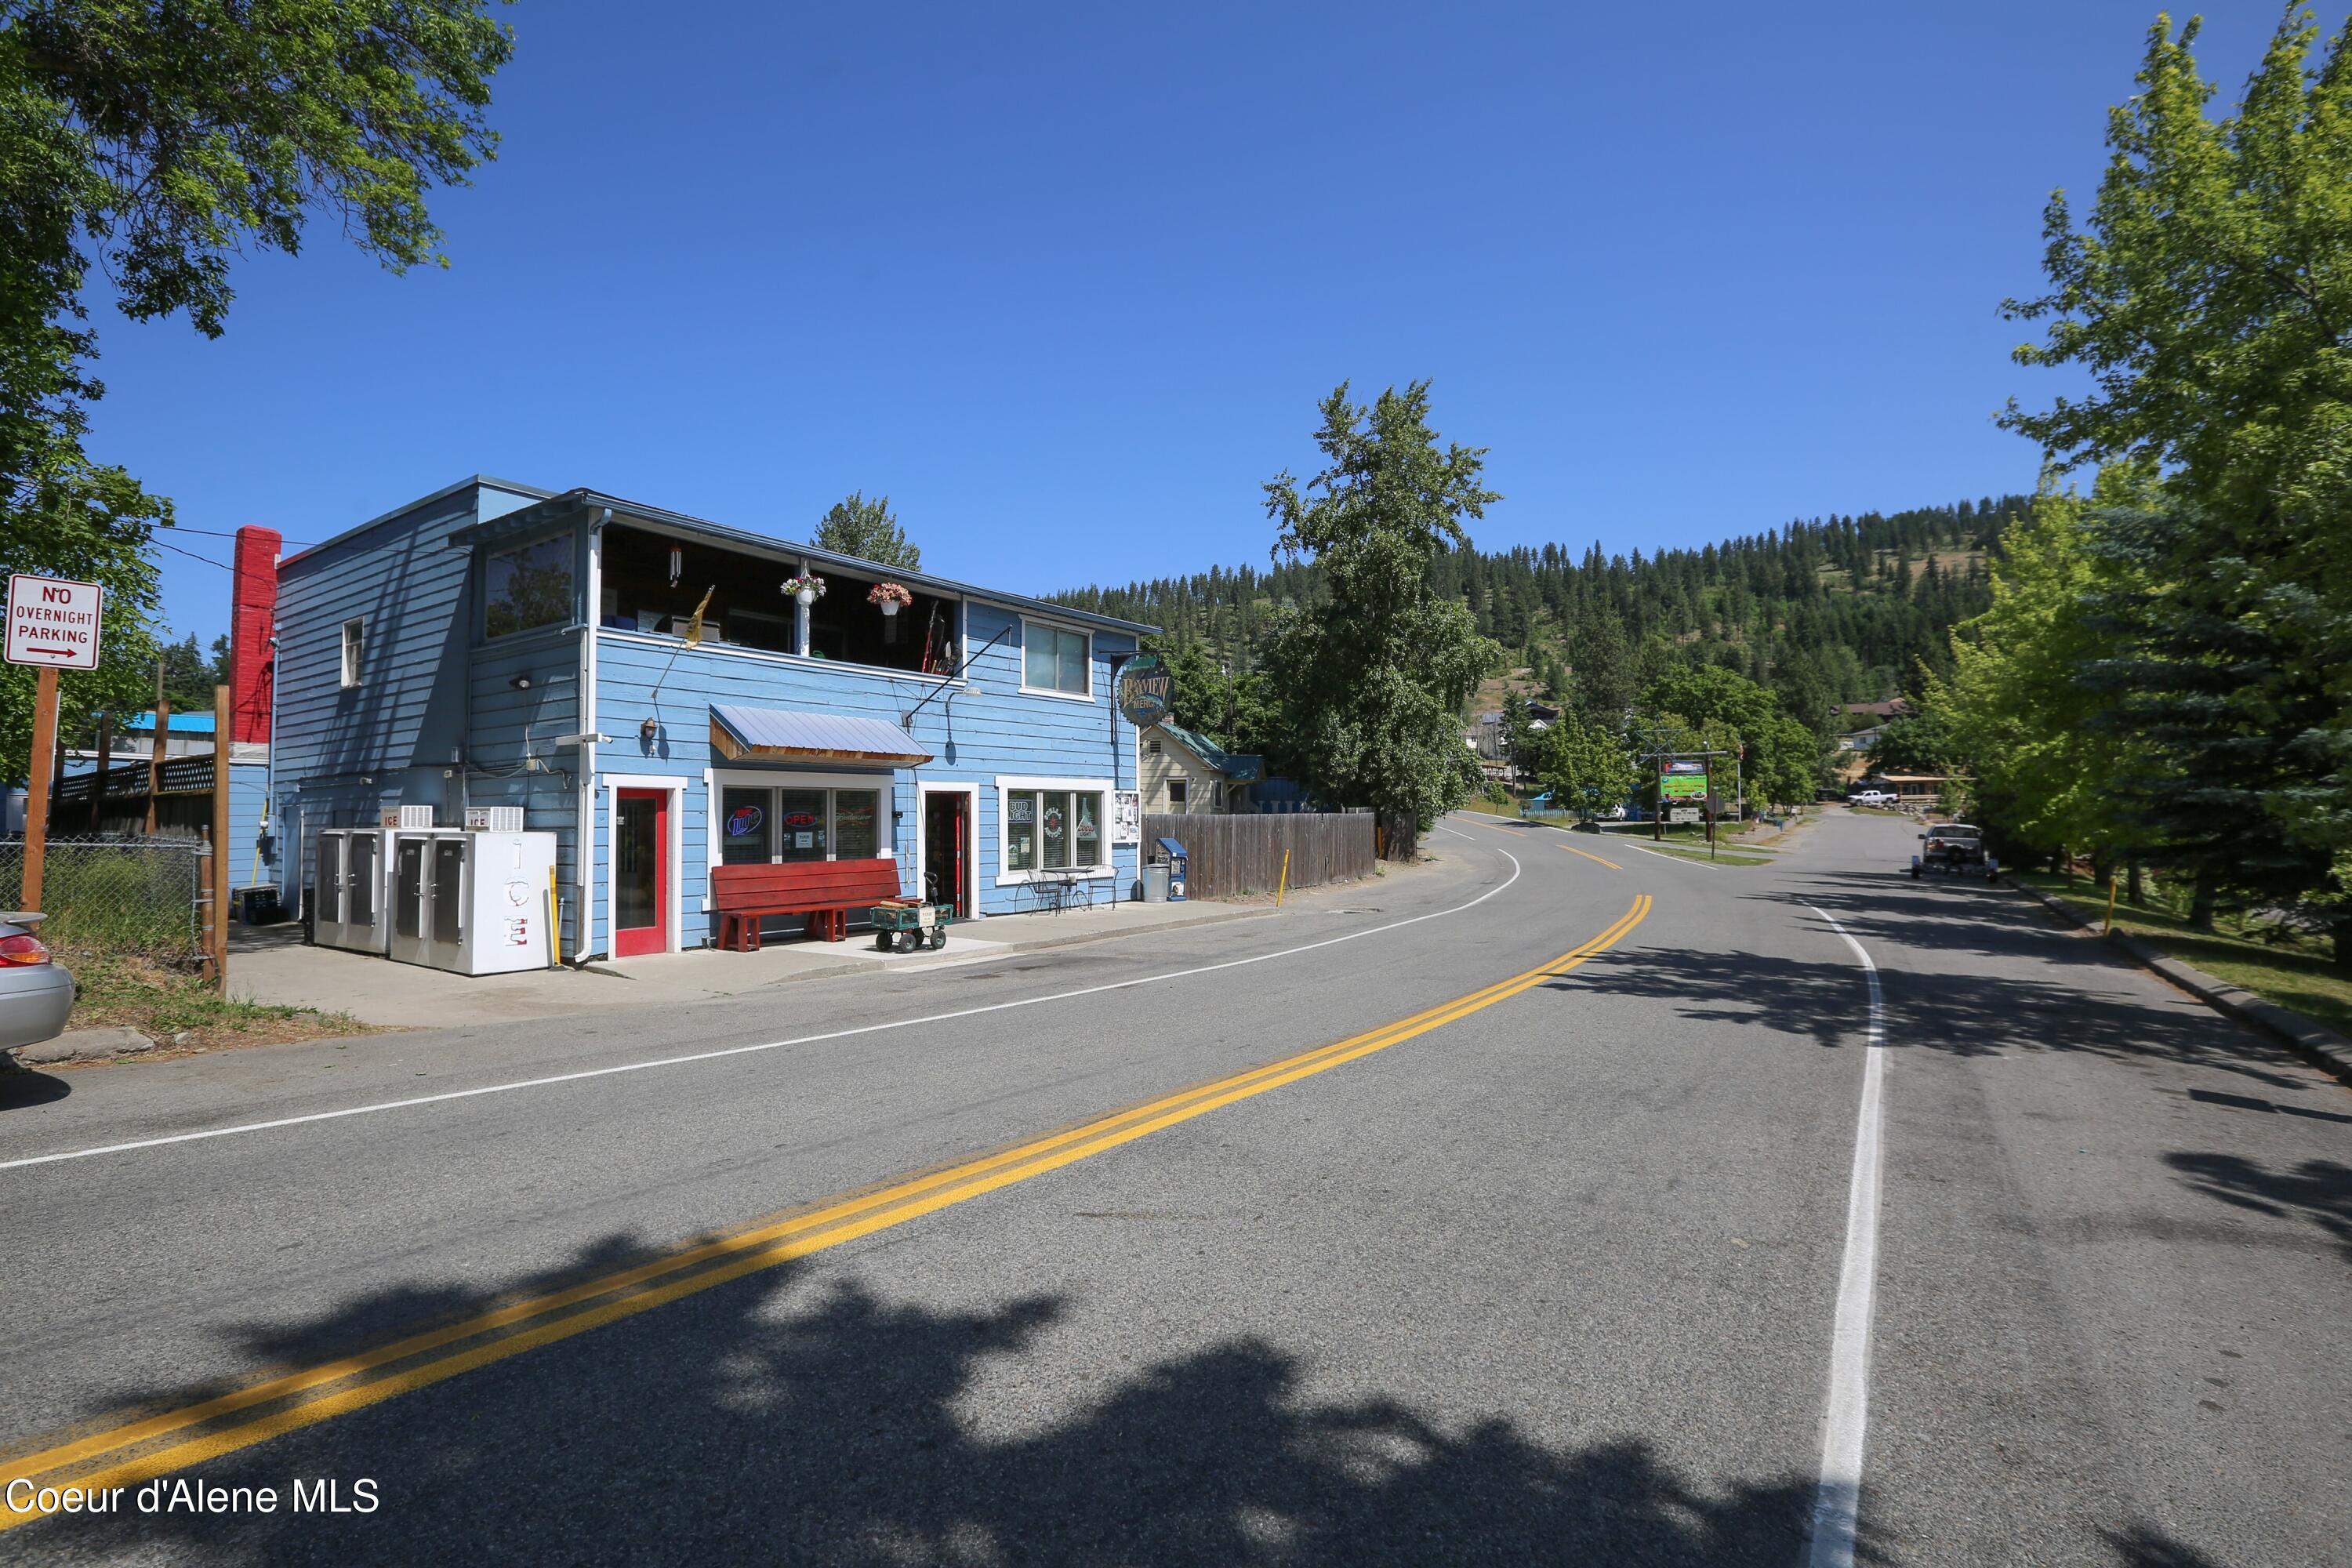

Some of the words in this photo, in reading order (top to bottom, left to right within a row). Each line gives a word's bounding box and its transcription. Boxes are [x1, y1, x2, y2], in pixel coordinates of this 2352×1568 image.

[42, 586, 71, 604] NO
[16, 605, 93, 625] OVERNIGHT
[19, 626, 88, 644] PARKING
[1123, 677, 1171, 709] BAYVIEW
[1010, 801, 1028, 811] BUD
[385, 815, 397, 826] ICE
[785, 815, 816, 826] OPEN
